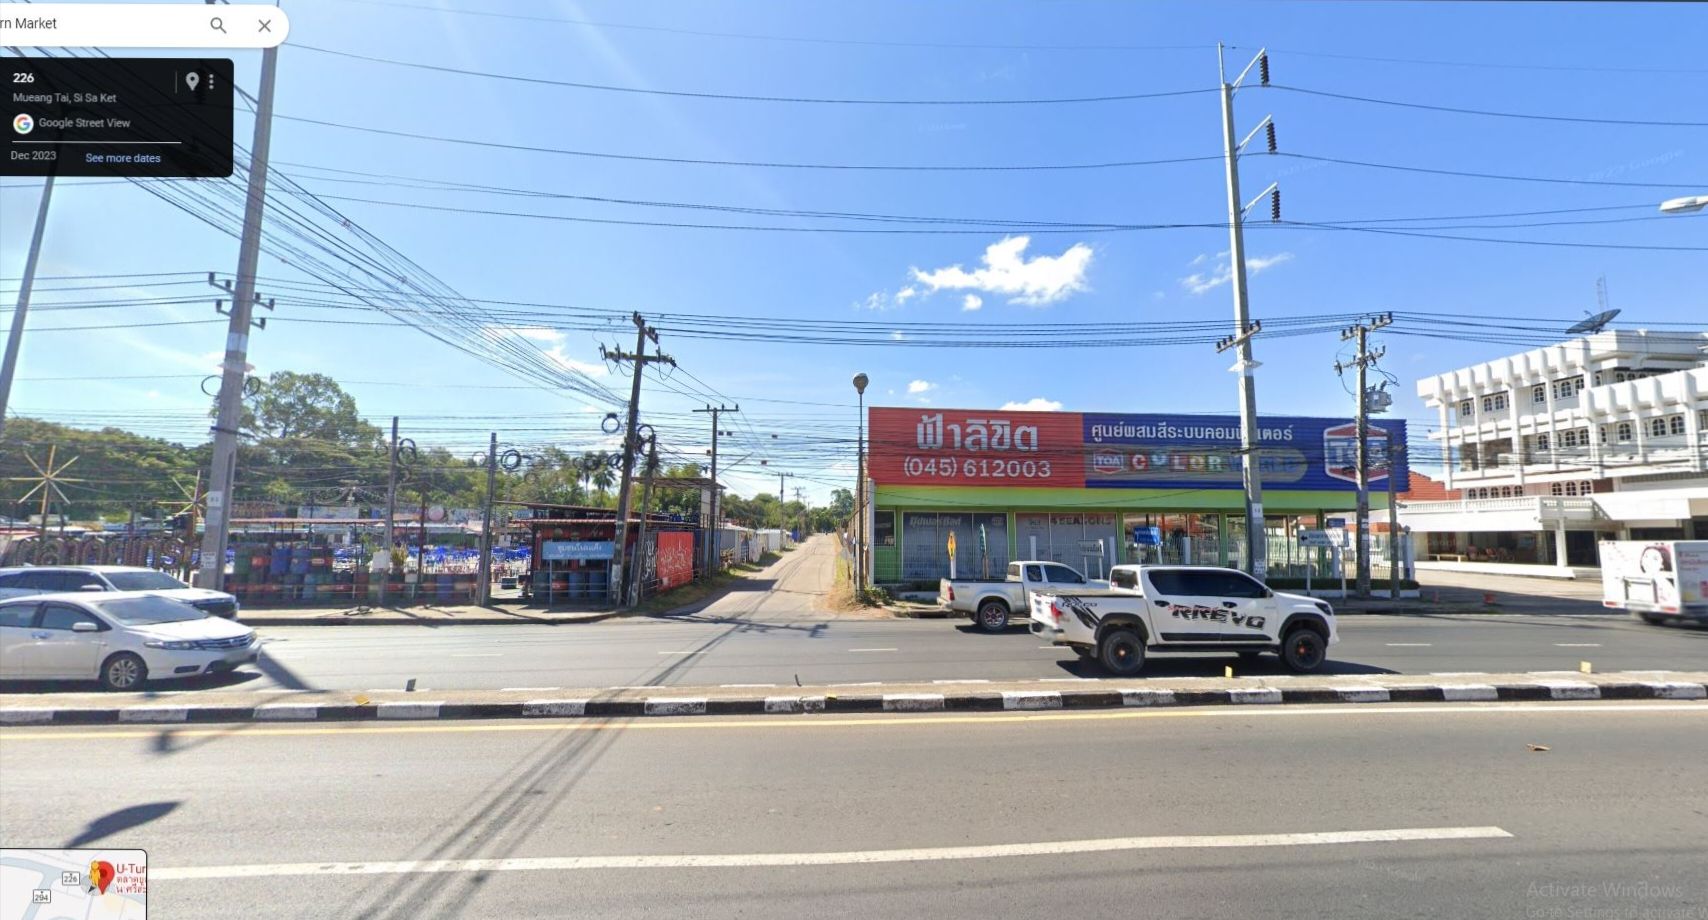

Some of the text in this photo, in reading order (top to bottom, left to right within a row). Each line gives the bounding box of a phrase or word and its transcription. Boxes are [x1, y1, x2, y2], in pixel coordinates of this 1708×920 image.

[916, 413, 1039, 451] ฟ้าลิขิต
[904, 456, 1051, 478] (045) 612003
[1095, 456, 1120, 465] TOA
